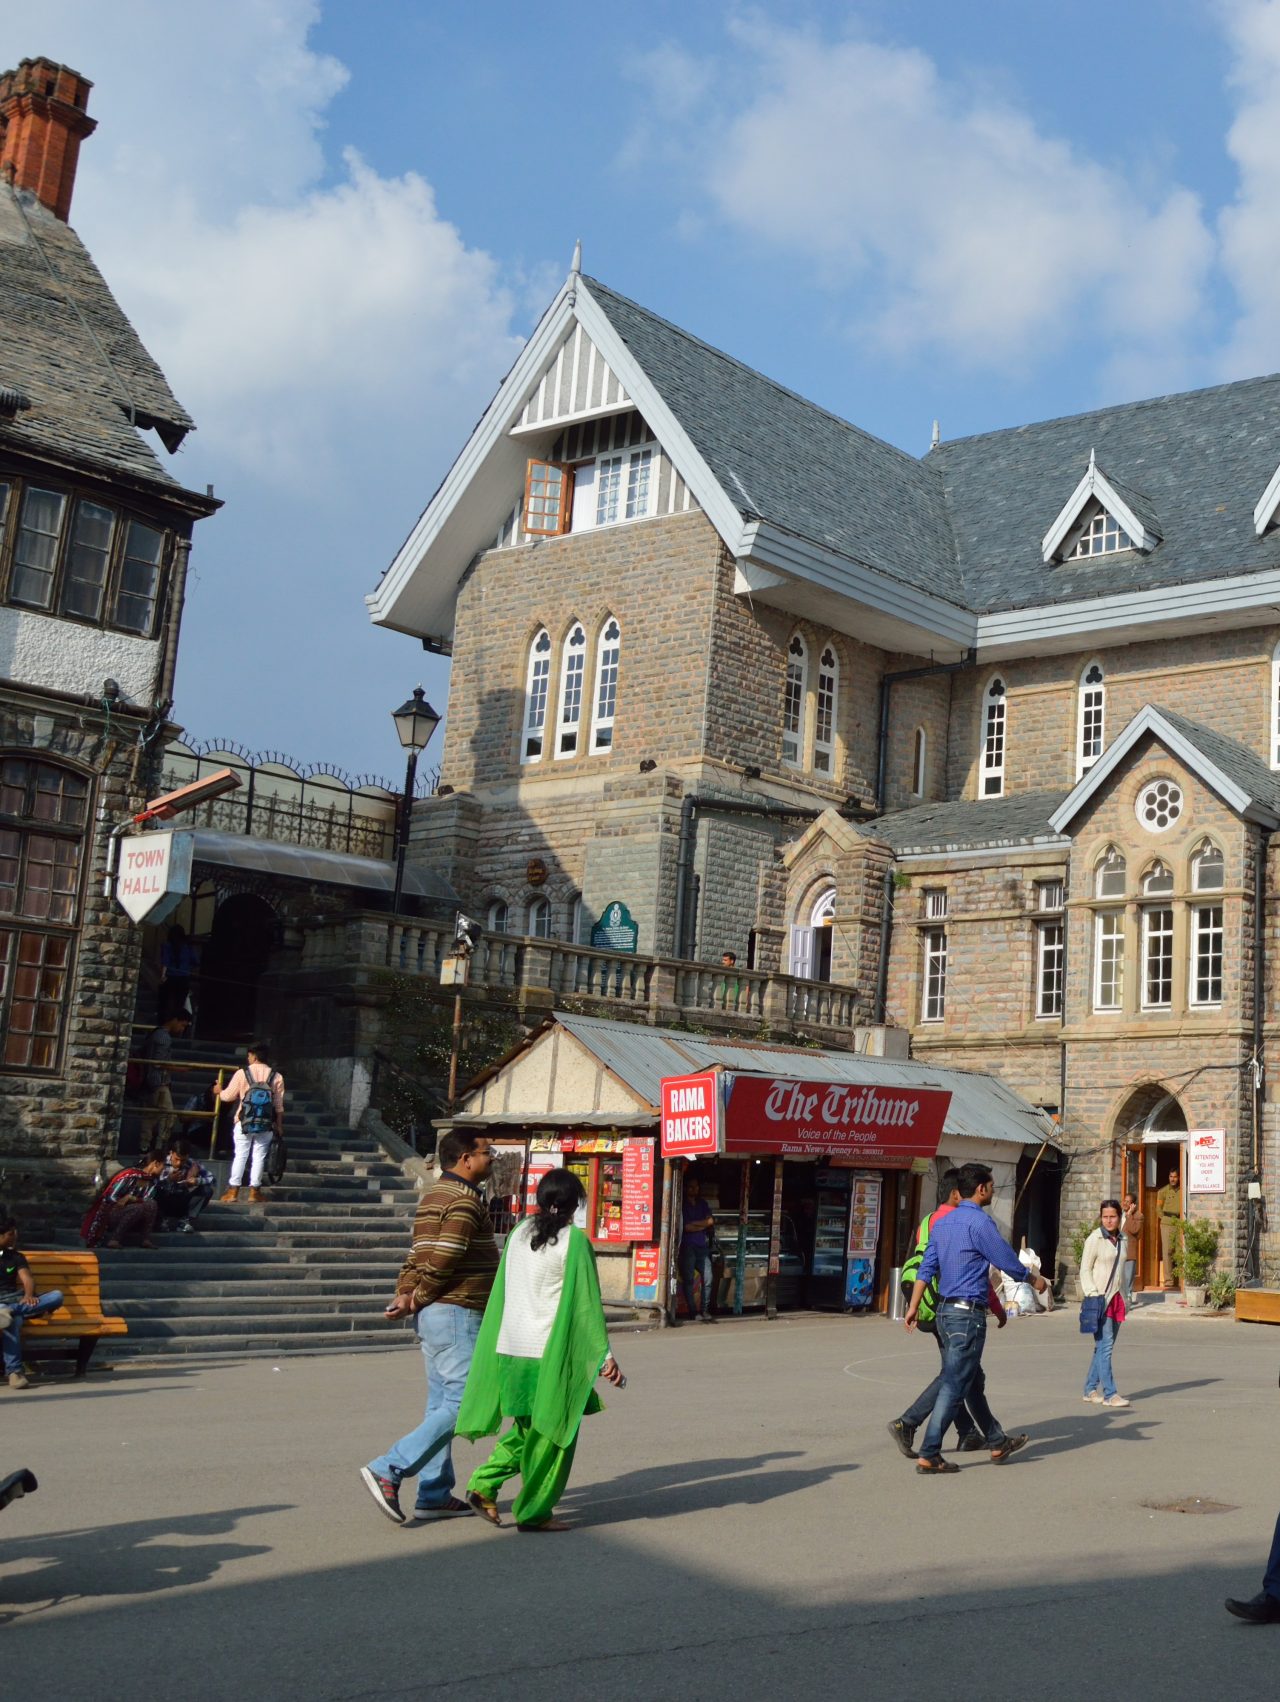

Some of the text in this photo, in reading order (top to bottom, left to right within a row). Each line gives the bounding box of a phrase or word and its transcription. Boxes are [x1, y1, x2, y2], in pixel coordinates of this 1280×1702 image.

[127, 848, 165, 870] TOWN
[122, 875, 160, 896] HALL
[670, 1086, 706, 1113] RAMA
[764, 1080, 920, 1127] The Tribune
[666, 1115, 711, 1143] BAKERS
[797, 1127, 877, 1142] Voice of the People
[780, 1143, 802, 1152] Rama
[804, 1144, 824, 1153] News
[825, 1145, 852, 1156] Agency
